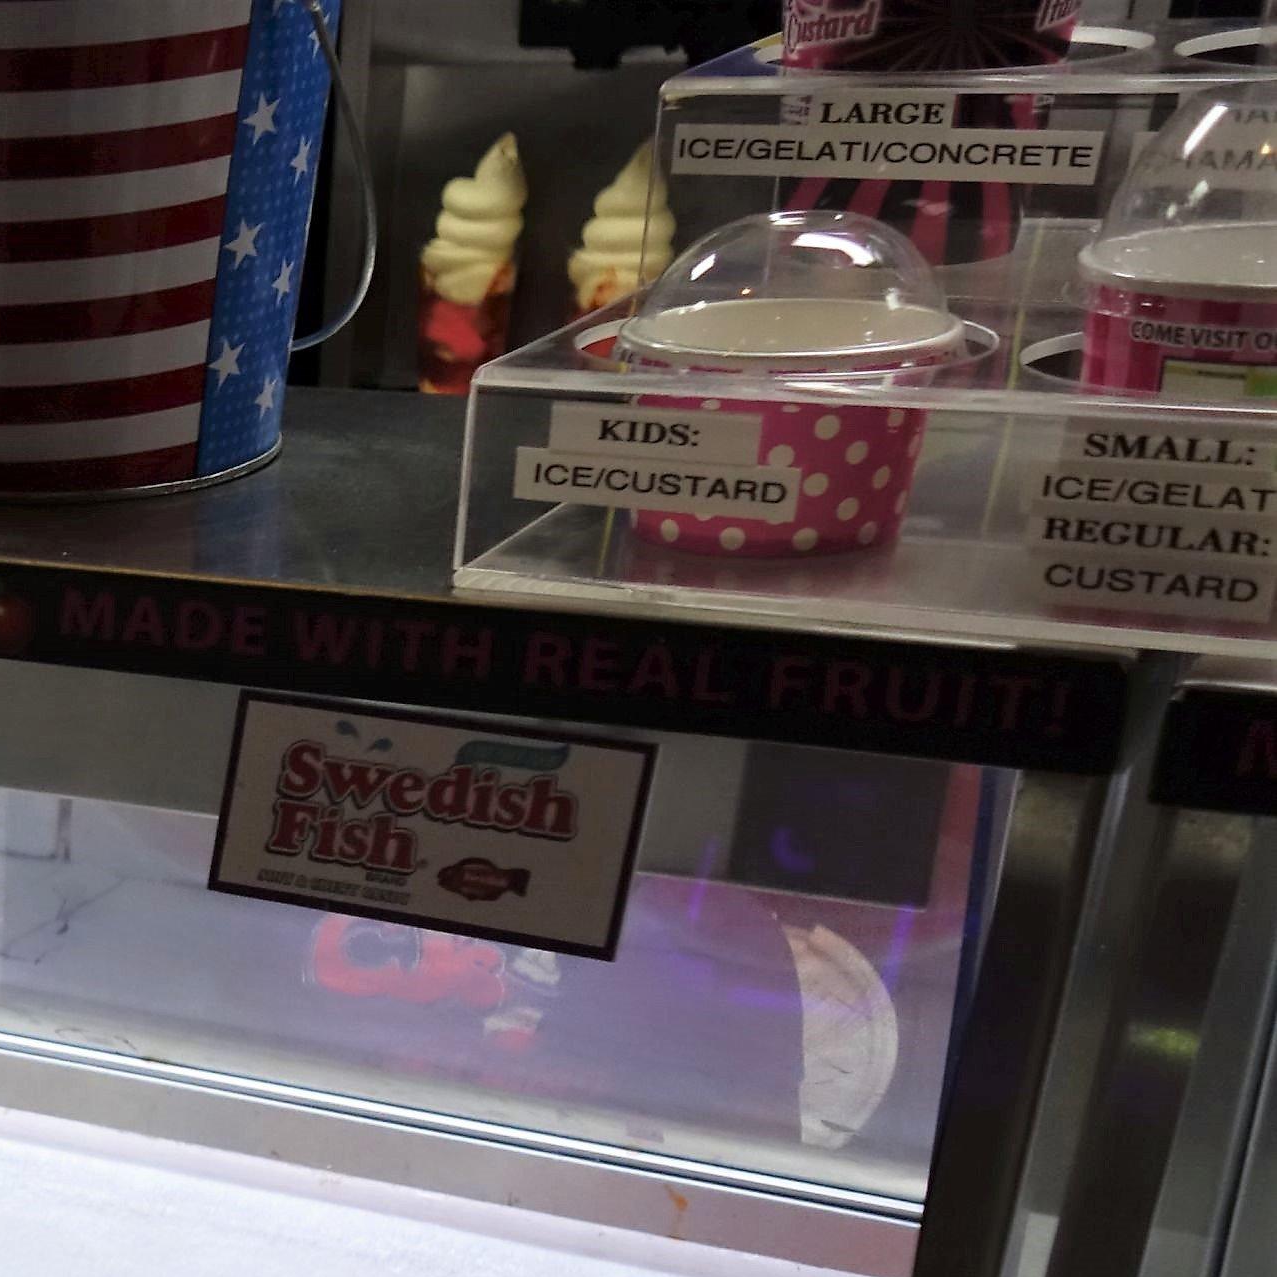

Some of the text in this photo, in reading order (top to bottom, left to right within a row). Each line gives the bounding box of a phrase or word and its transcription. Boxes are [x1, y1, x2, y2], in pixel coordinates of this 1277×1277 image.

[820, 101, 945, 126] LARGE
[678, 136, 1094, 169] ICE/GELATI/CONCRETE
[1131, 320, 1186, 345] COME
[1191, 328, 1249, 349] VISIT
[597, 418, 700, 447] KIDS:
[1083, 432, 1256, 467] SMALL:
[533, 461, 789, 505] ICE/CUSTARD
[1042, 517, 1270, 557] REGULAR:
[1044, 563, 1258, 603] CUSTARD
[58, 584, 1077, 737] MADE WITH REAL FRUIT!
[278, 739, 578, 842] Swedish
[266, 798, 418, 875] Fish
